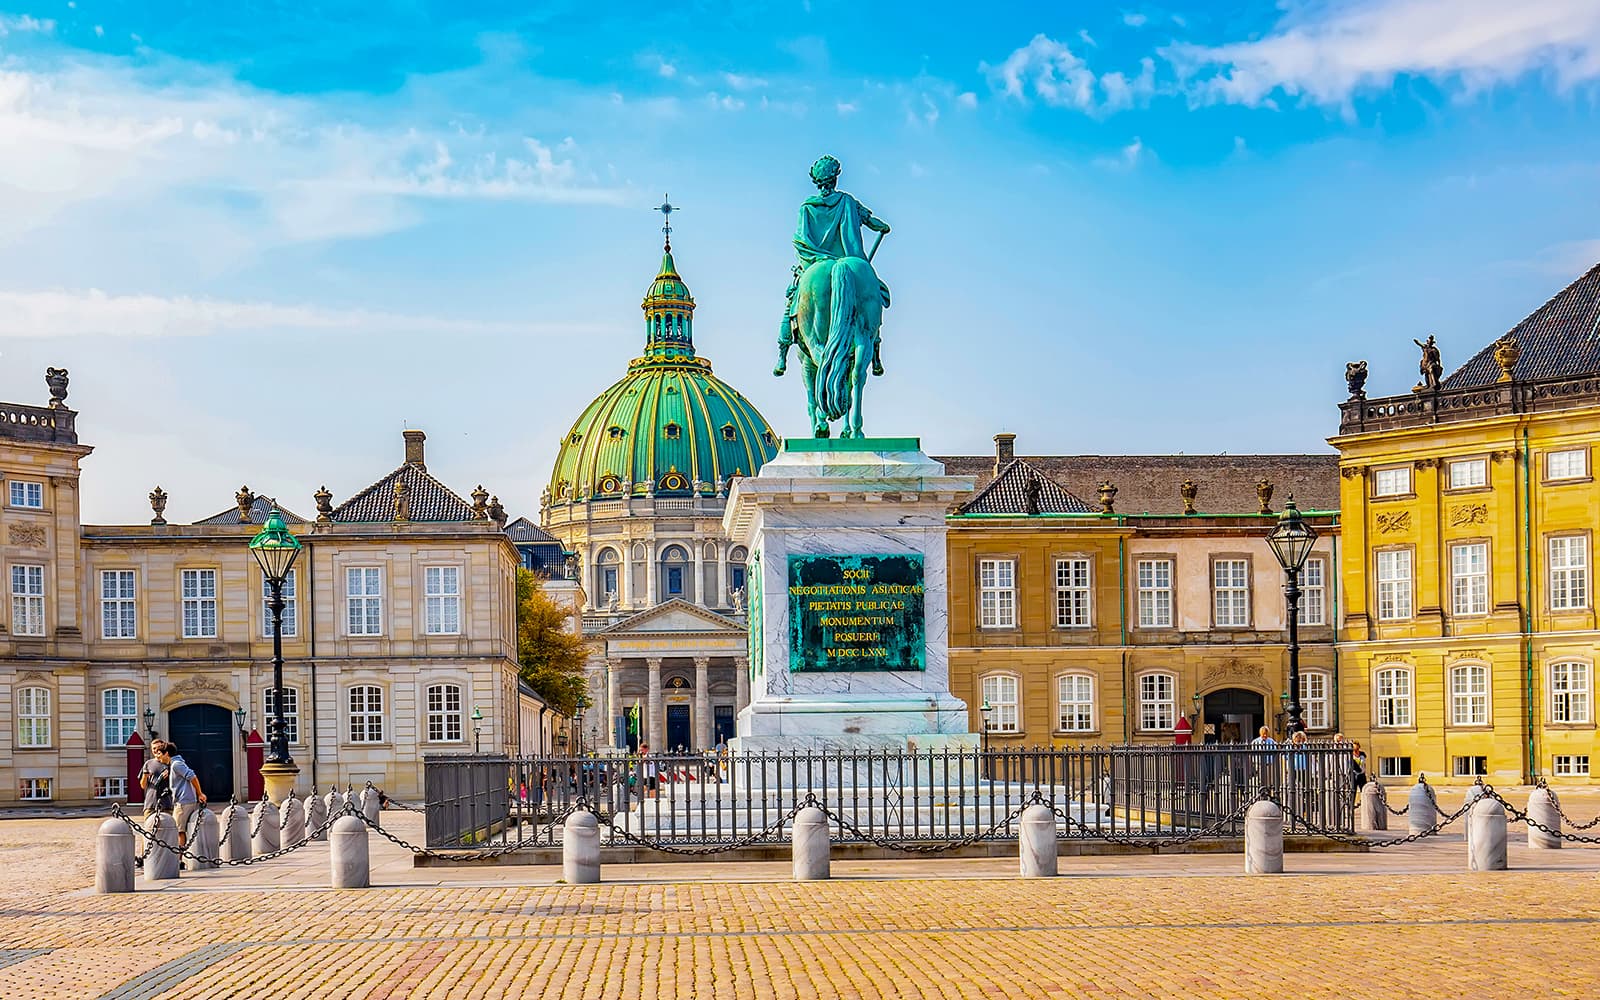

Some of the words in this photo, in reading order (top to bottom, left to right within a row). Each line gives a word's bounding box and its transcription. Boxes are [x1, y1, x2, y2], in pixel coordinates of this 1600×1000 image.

[789, 586, 866, 596] NEGOTIATIONIS
[809, 601, 851, 611] PIETATIS
[820, 617, 894, 626] MONUMENTUM
